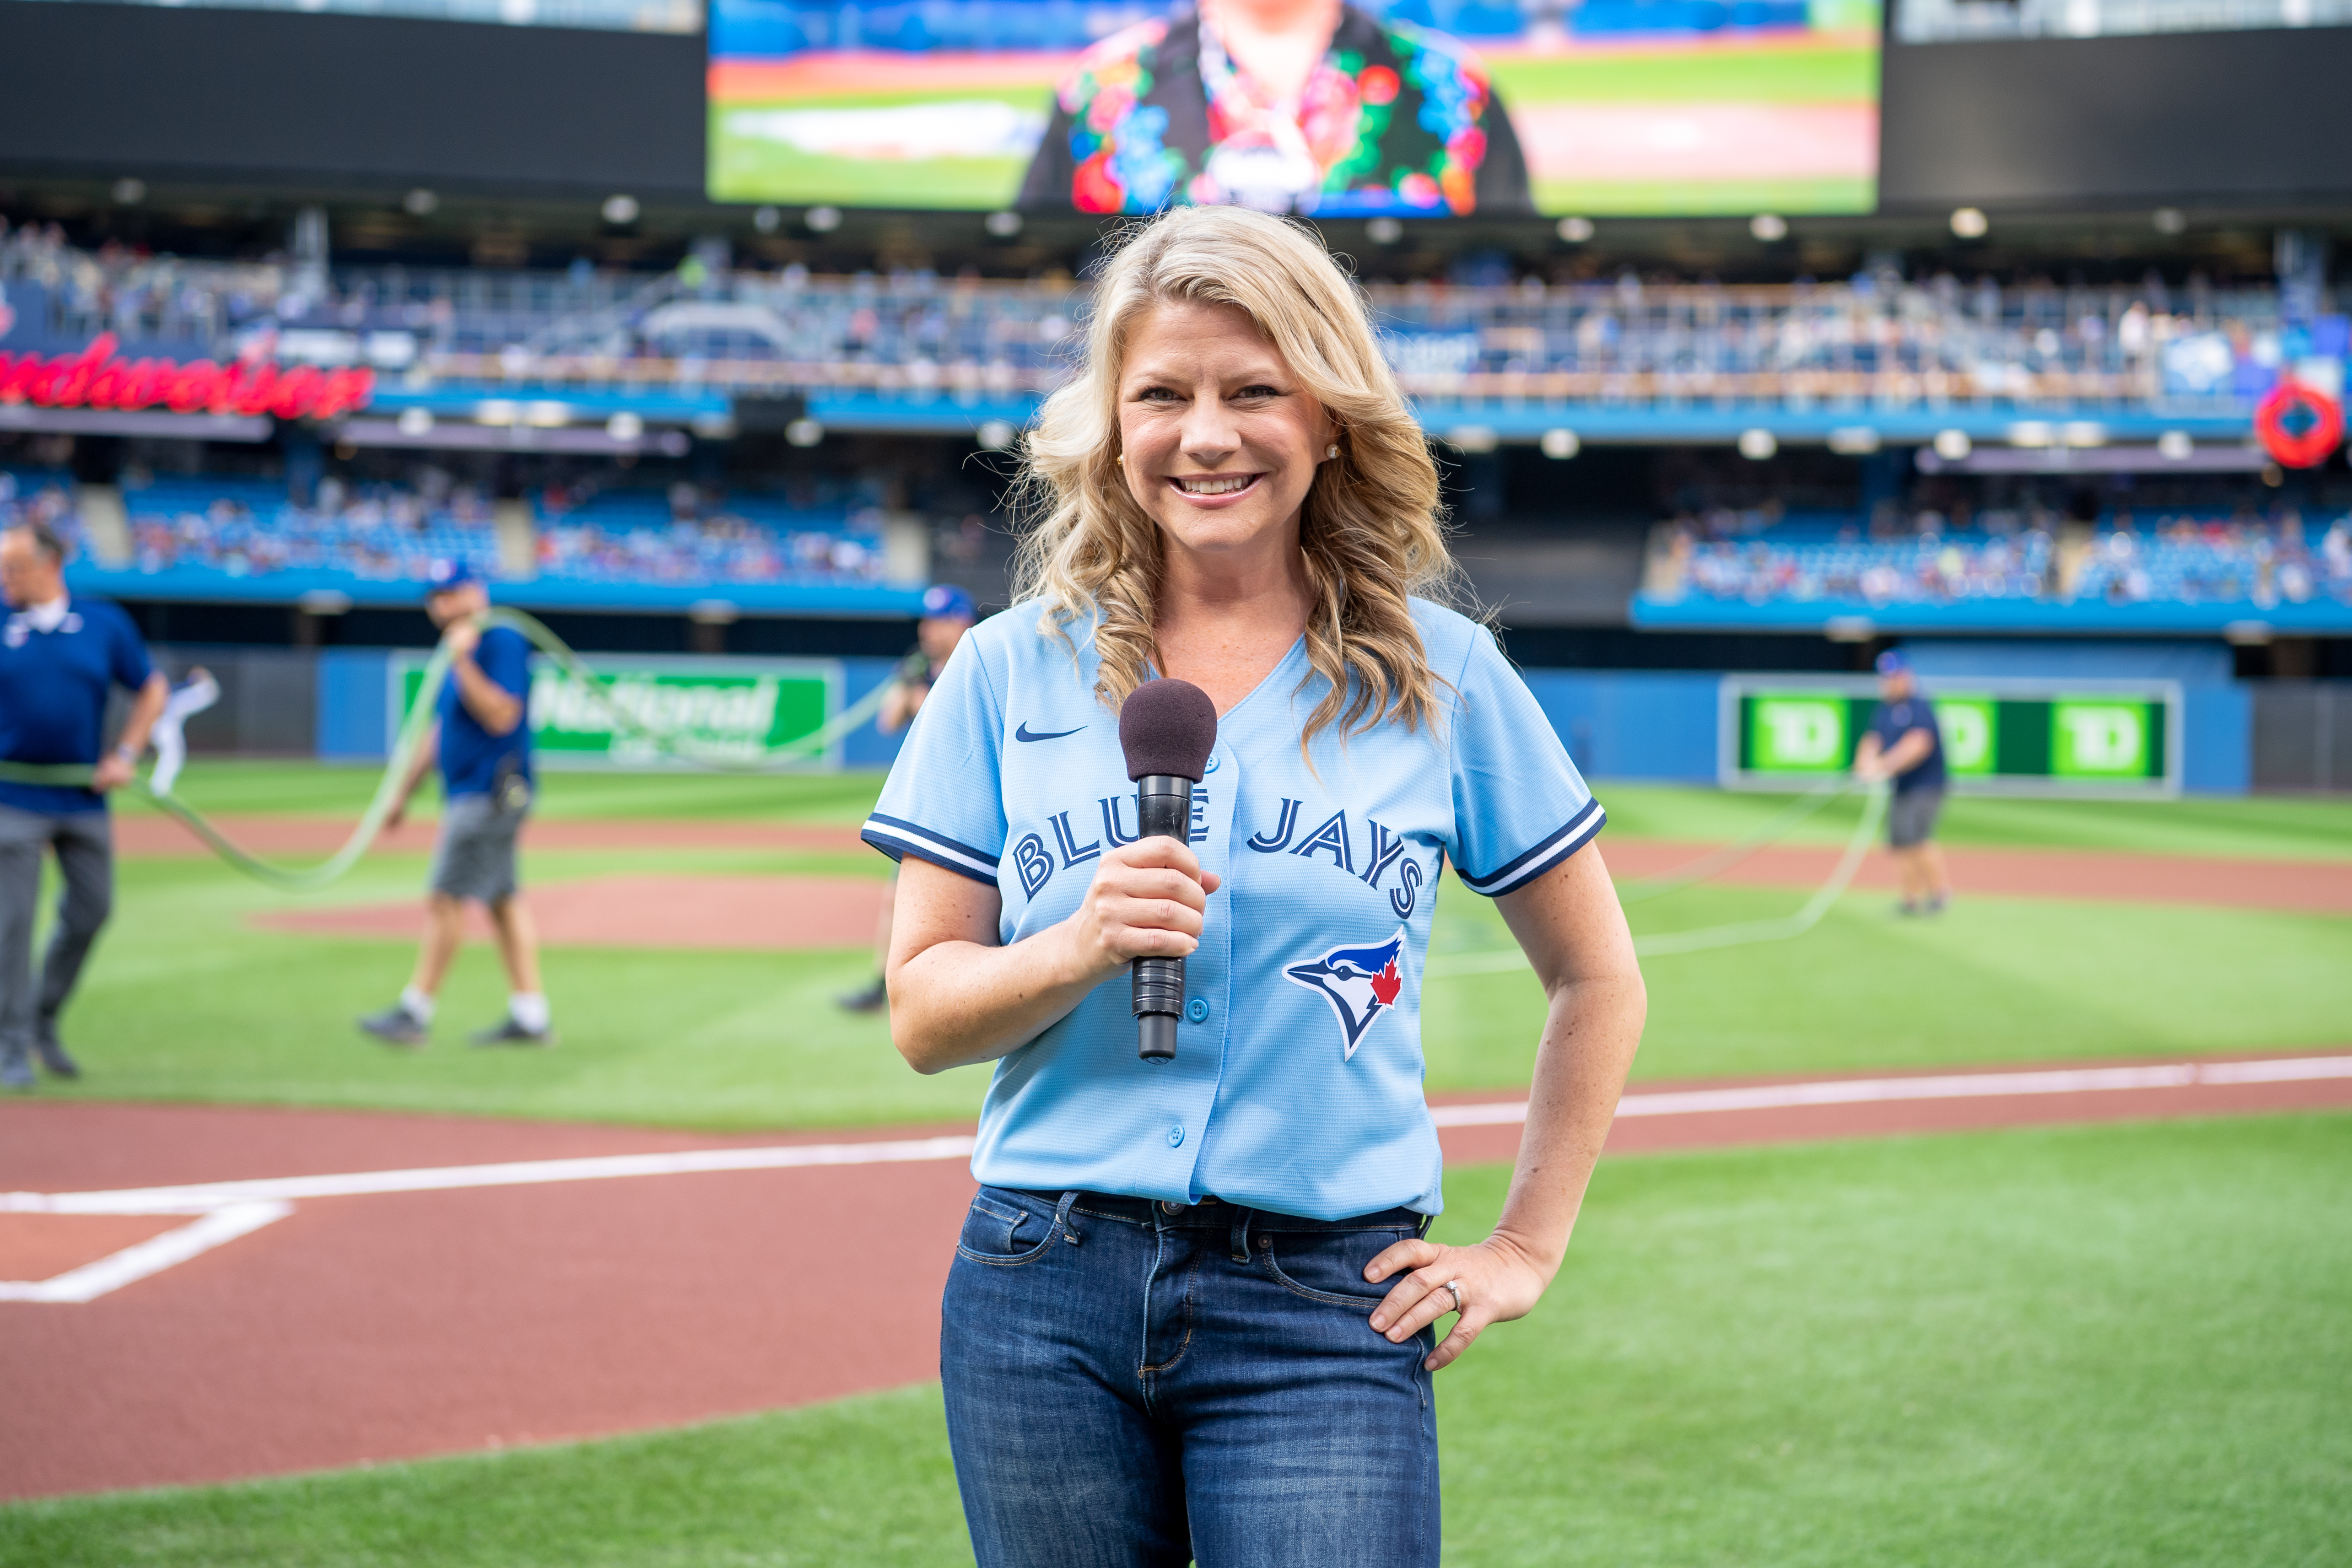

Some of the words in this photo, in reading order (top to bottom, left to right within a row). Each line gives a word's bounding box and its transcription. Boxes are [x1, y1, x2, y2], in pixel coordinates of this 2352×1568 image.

[1756, 701, 1841, 767] TD
[1936, 705, 1988, 768] D
[2057, 706, 2142, 771] TD
[1246, 798, 1422, 920] JAYS
